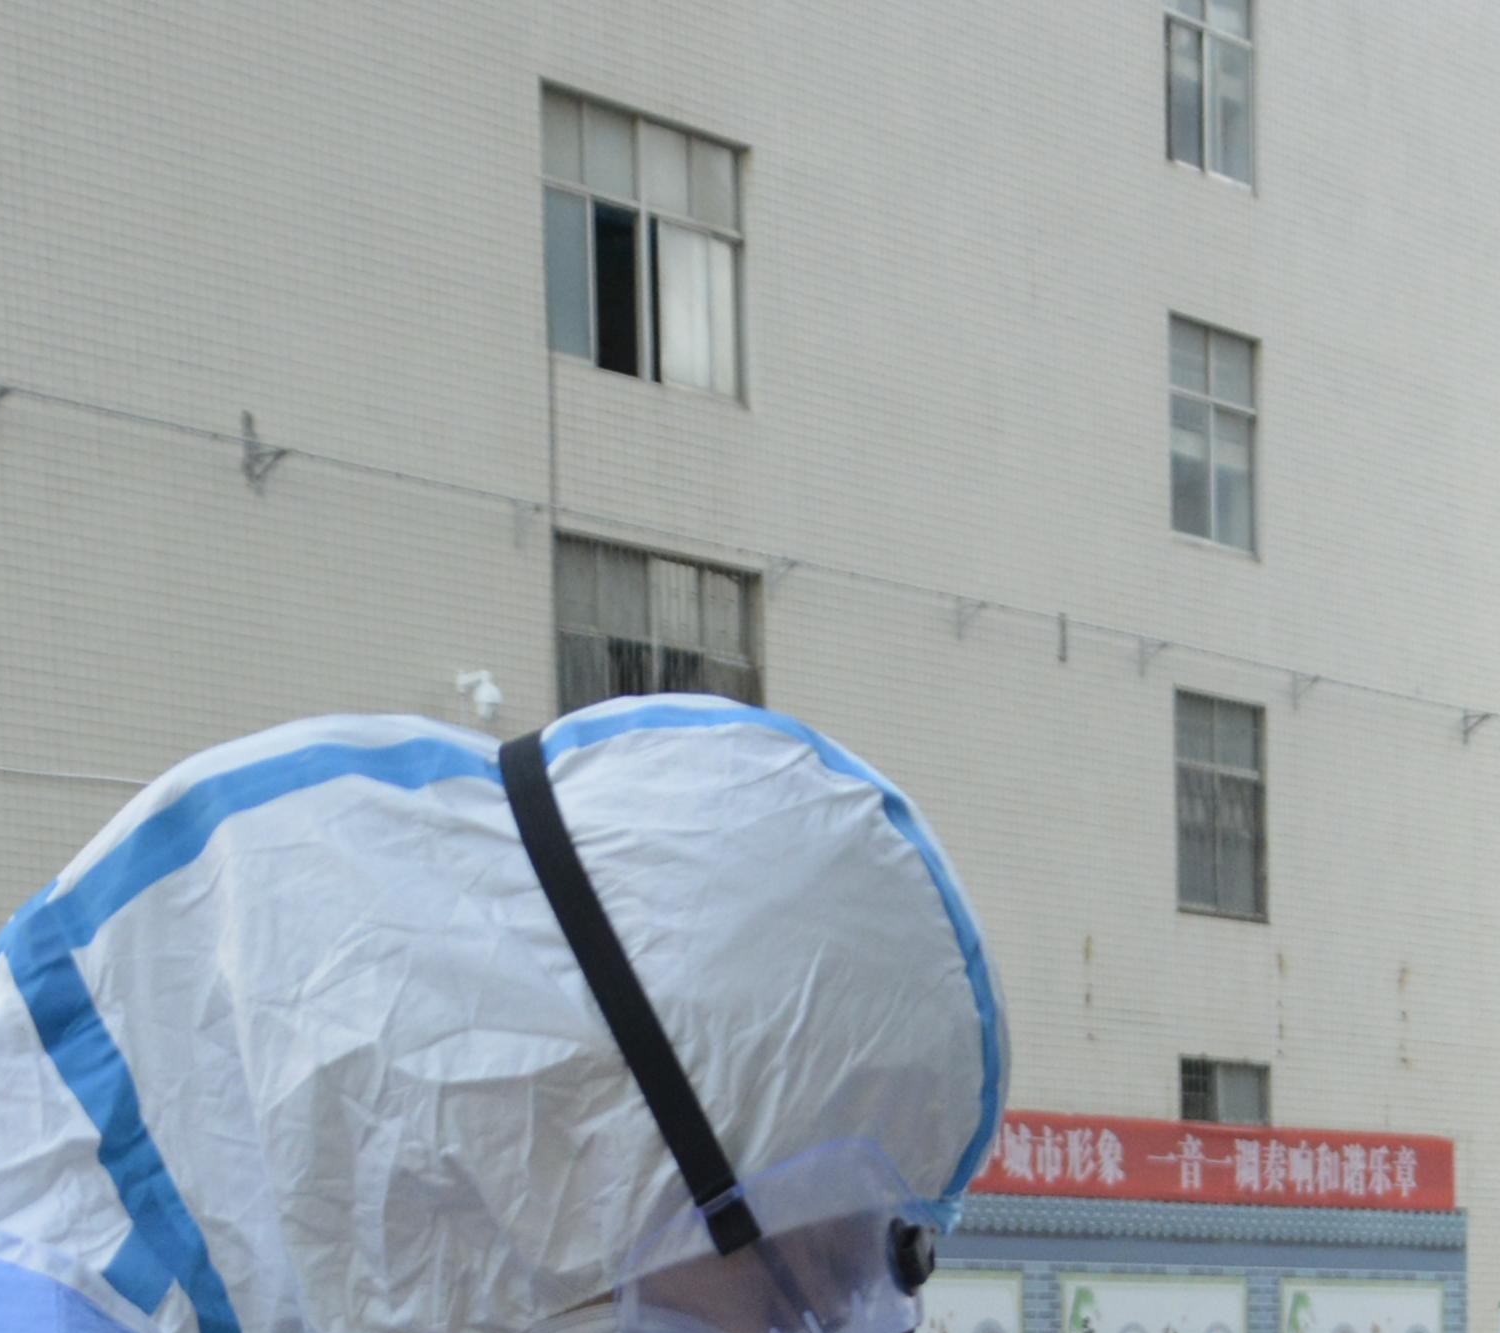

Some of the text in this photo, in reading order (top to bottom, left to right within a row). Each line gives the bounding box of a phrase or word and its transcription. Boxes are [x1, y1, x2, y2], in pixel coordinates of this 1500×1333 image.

[1147, 1134, 1419, 1198] 一音一调奏响和谐乐章
